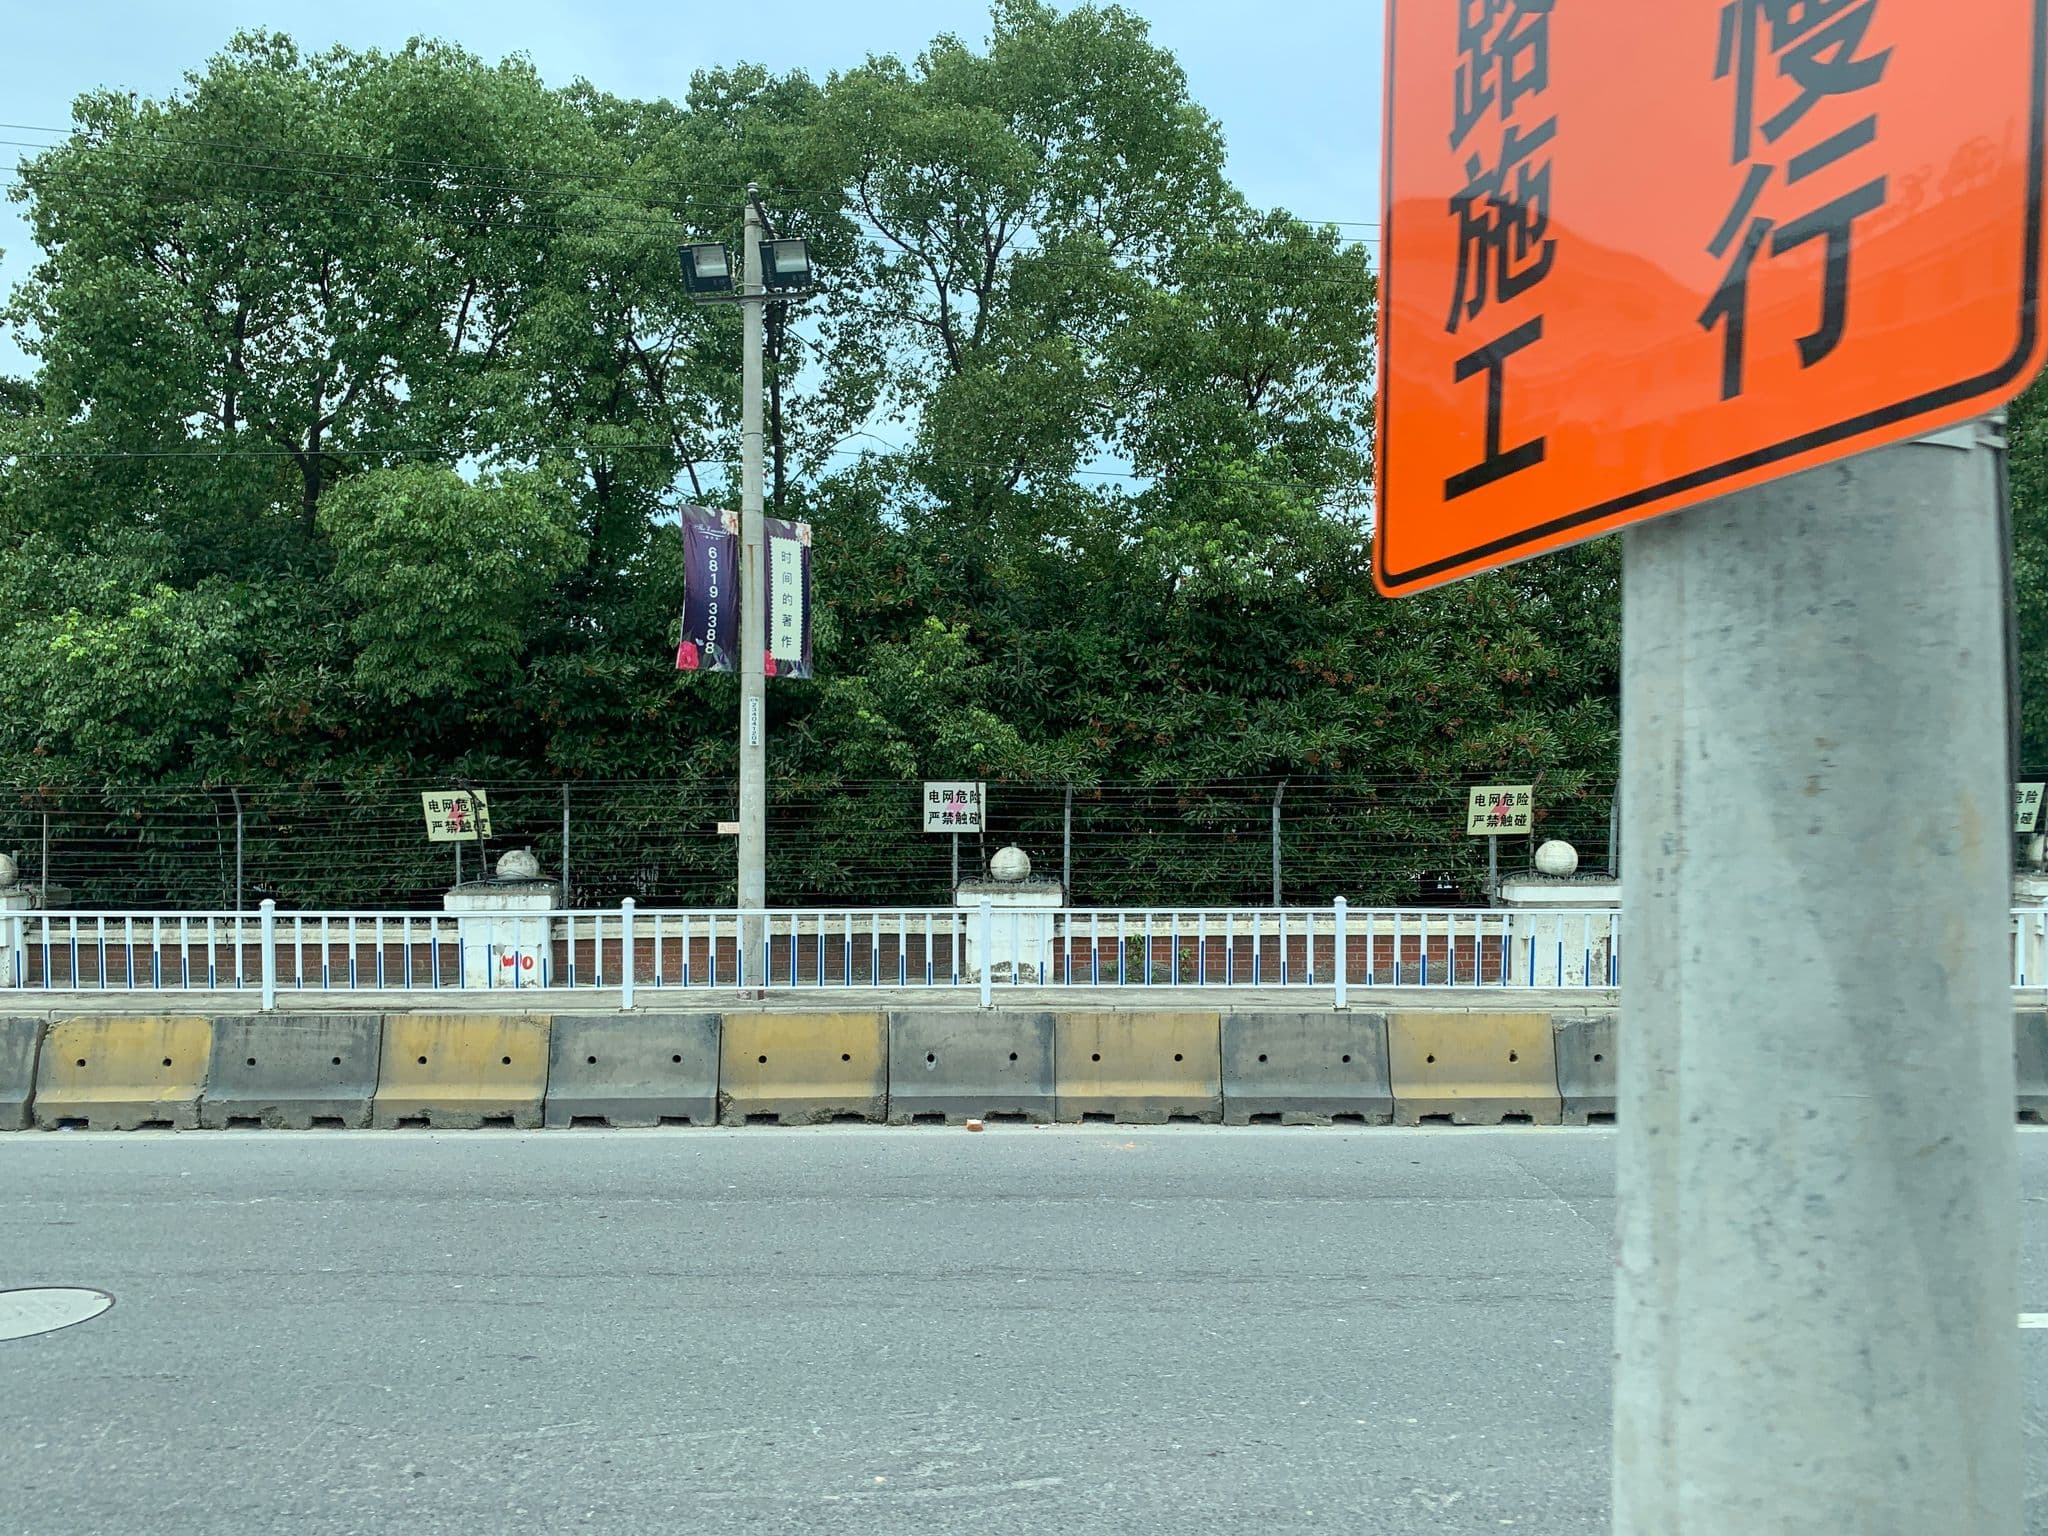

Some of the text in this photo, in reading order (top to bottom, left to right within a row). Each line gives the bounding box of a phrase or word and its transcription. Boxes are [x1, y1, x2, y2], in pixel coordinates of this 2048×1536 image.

[1445, 0, 1558, 502] 路施工
[781, 551, 793, 649] 时间的著作
[1472, 814, 1528, 828] 严禁触碰
[1474, 792, 1529, 807] 电网危险
